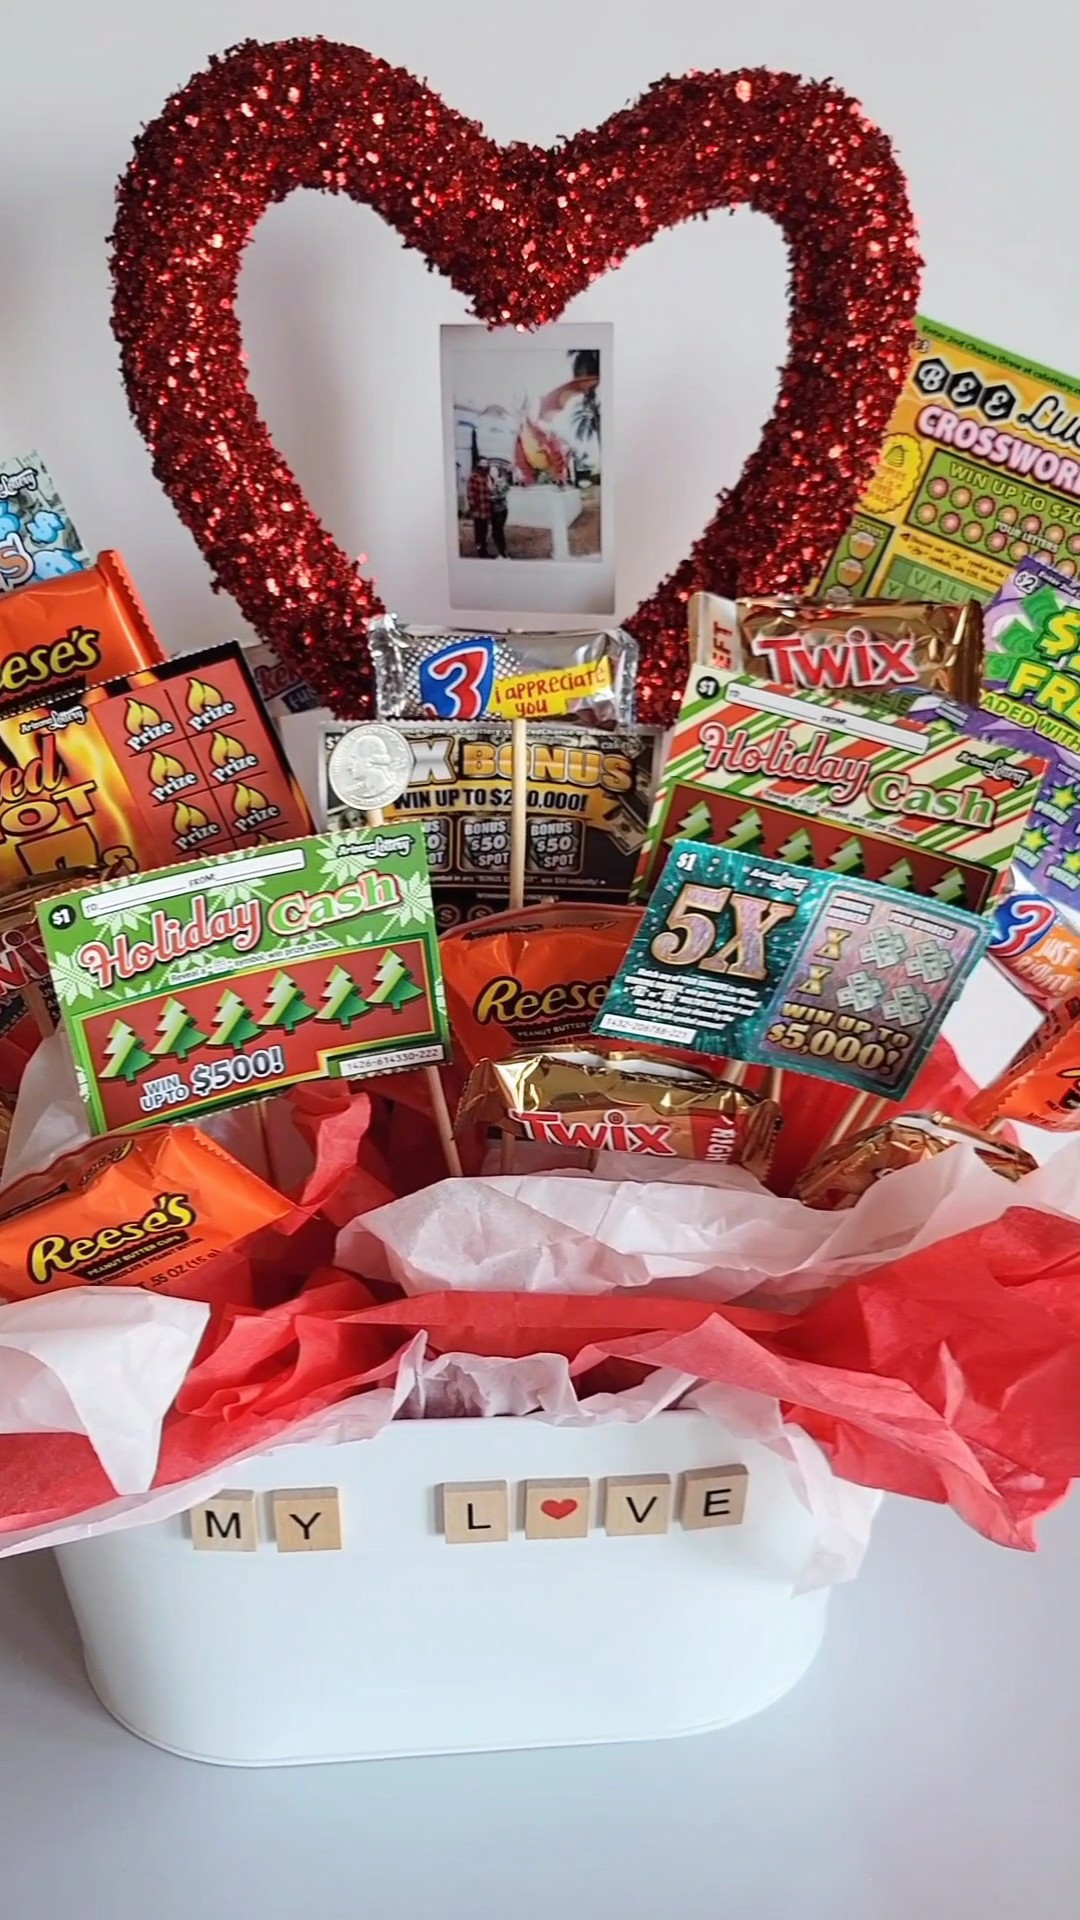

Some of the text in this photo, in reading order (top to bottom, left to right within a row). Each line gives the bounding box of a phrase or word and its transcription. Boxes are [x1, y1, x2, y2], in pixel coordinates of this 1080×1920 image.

[914, 359, 1014, 420] BEE
[916, 404, 1080, 498] CROSSWOR
[950, 462, 988, 490] WIN
[991, 479, 1018, 500] UP
[1020, 490, 1046, 512] TO
[995, 520, 1023, 540] YOUR
[1021, 532, 1060, 554] LETTERS
[1016, 571, 1038, 593] $2
[712, 620, 733, 670] EFT
[0, 629, 99, 692] ese's
[427, 646, 489, 720] 3
[698, 681, 717, 696] $1
[188, 701, 236, 731] Prize
[515, 699, 548, 717] you
[982, 693, 1038, 728] ADED
[127, 721, 175, 751] Prize
[0, 732, 64, 803] ed
[211, 753, 259, 783] Prize
[409, 737, 458, 784] X
[462, 741, 634, 793] BONUS
[699, 721, 998, 829] Holiday Cash
[150, 772, 198, 802] Prize
[394, 788, 589, 812] WIN UP TO $20,000!
[0, 780, 99, 846] OT
[233, 804, 281, 833] Prize
[175, 822, 221, 851] Prize
[464, 821, 506, 836] BONUS
[470, 834, 507, 852] $50
[530, 822, 573, 837] BONUS
[428, 852, 444, 864] OT
[478, 852, 510, 867] SPOT
[536, 836, 572, 853] $50
[544, 854, 575, 868] SPOT
[677, 853, 698, 871] $1
[51, 908, 71, 926] $1
[78, 894, 263, 988] Holiday
[268, 870, 402, 937] Cash
[651, 882, 799, 981] 5X
[1032, 938, 1079, 967] JUST
[477, 978, 610, 1024] Reese
[517, 1022, 586, 1038] PEANUT BUTTER
[781, 1002, 912, 1049] WIN UP TO
[766, 1022, 901, 1076] $5,000!
[145, 1076, 180, 1095] WIN
[191, 1045, 285, 1096] $500!
[704, 1127, 737, 1163] RIGH
[30, 1192, 195, 1284] Reese's
[86, 1235, 182, 1276] PEANUT BUTTER CUPS
[166, 1264, 188, 1278] OZ
[205, 1508, 322, 1541] MY
